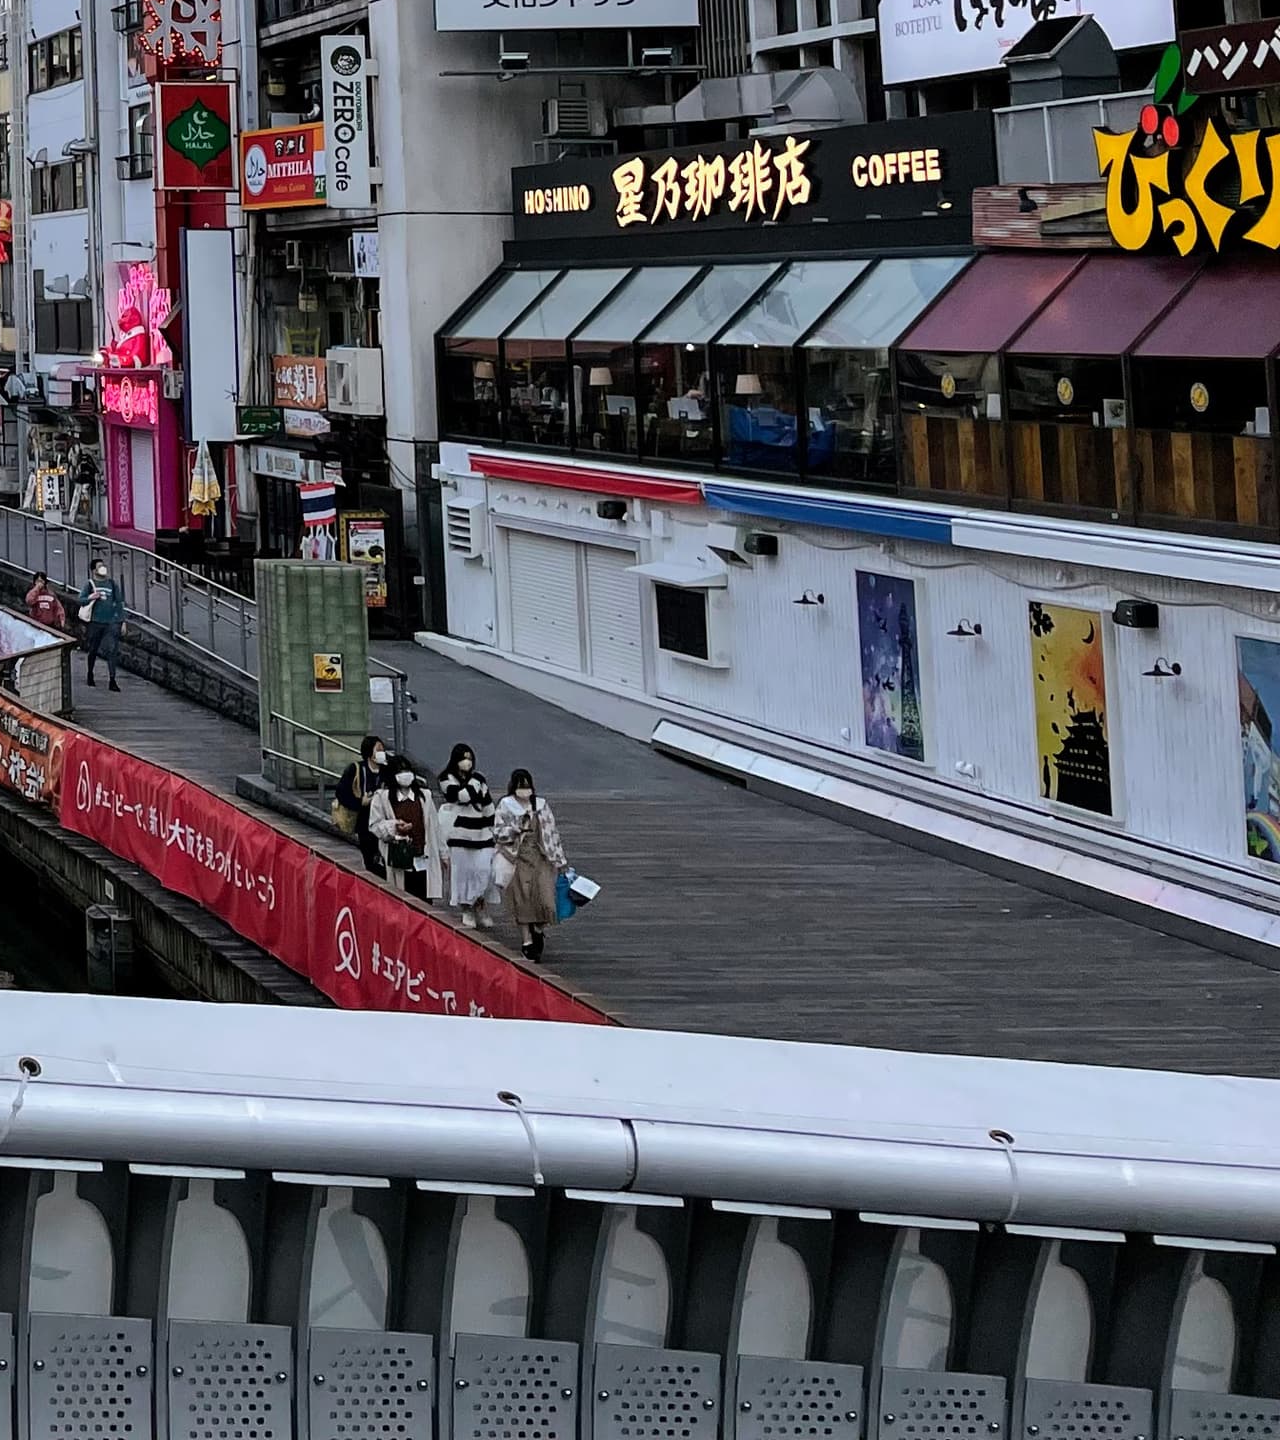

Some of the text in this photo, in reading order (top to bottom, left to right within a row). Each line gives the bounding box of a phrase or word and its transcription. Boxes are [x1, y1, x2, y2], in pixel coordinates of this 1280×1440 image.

[185, 141, 214, 150] HALAL
[267, 159, 313, 179] MITHILA
[334, 147, 352, 193] cafe
[610, 135, 814, 229] 星乃珈琲店
[851, 147, 943, 189] COFFEE
[523, 183, 591, 216] HOSHINO
